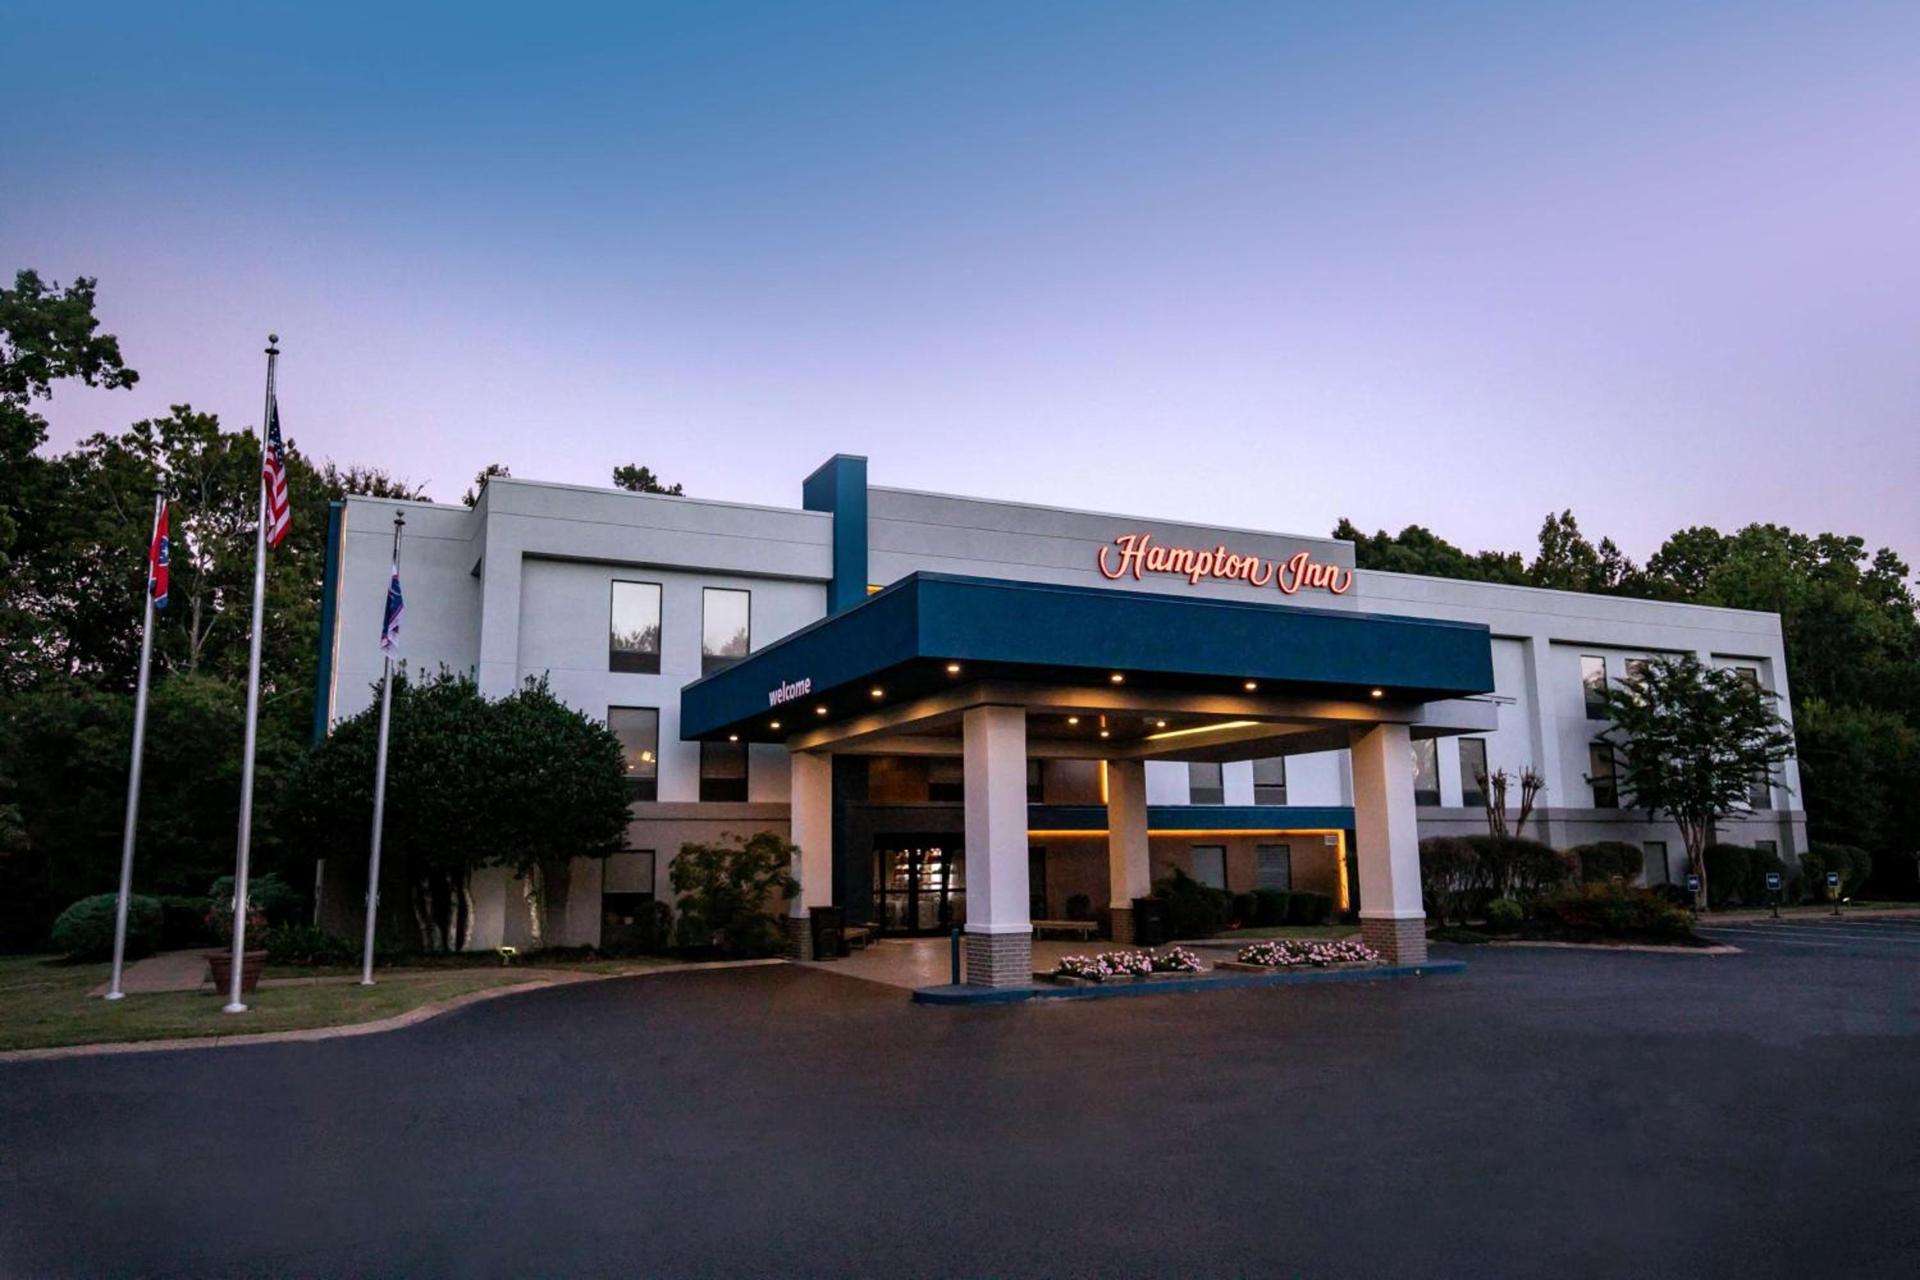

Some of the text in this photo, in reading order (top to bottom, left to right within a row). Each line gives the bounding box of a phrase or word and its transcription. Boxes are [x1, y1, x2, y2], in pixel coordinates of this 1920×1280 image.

[1098, 533, 1352, 594] Hampton Inn
[768, 677, 811, 706] welcome
